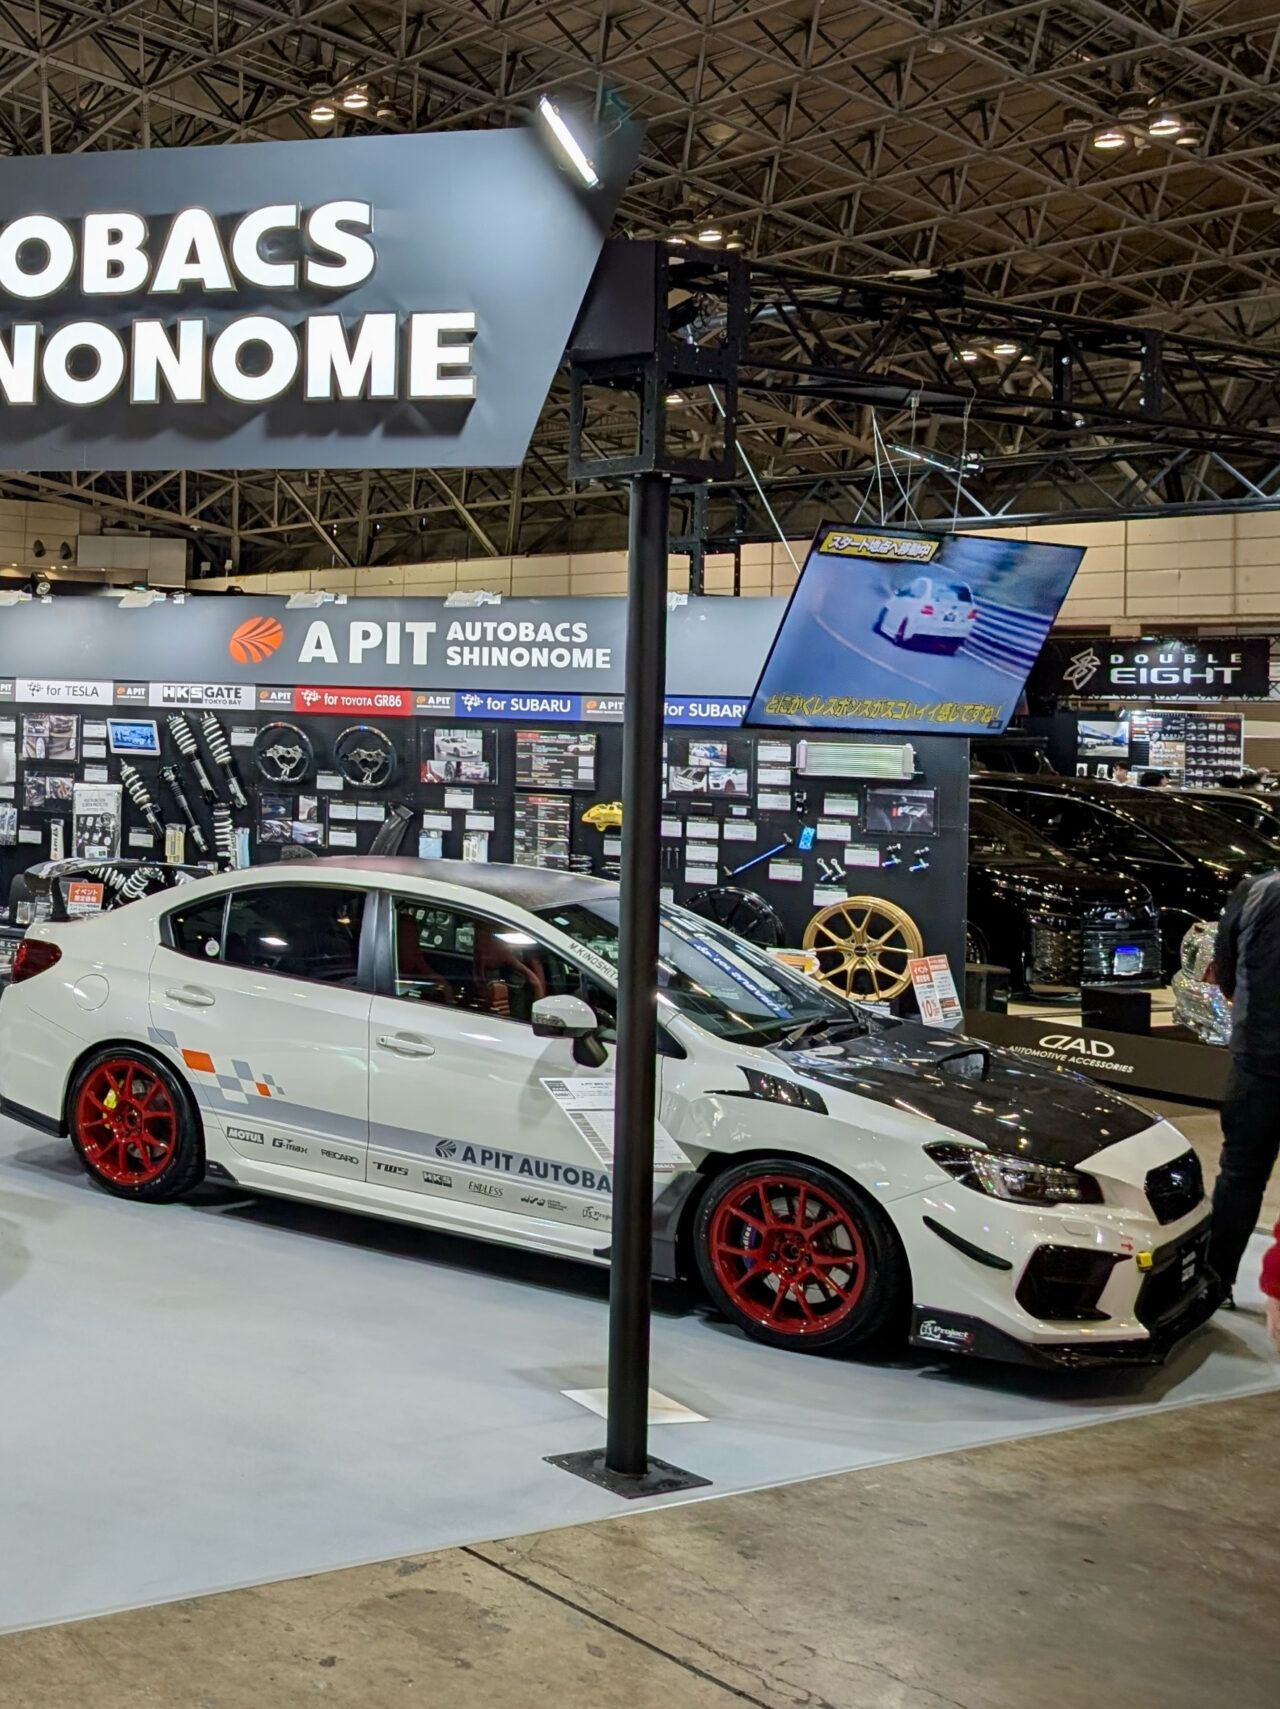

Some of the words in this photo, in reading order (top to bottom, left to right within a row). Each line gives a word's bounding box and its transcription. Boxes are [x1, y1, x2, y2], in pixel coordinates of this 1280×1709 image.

[446, 621, 589, 643] AUTOBACS
[446, 646, 612, 669] SHINONOME
[1110, 653, 1242, 665] DOUBLE
[1110, 667, 1242, 685] EIGHT
[46, 684, 62, 696] for
[65, 685, 100, 697] TESLA
[163, 685, 203, 704] HKS
[323, 692, 338, 706] for
[341, 696, 372, 707] TOYOTA
[373, 693, 403, 708] GR86
[486, 697, 507, 711] for
[510, 698, 571, 713] SUBARU
[663, 702, 685, 717] for
[688, 702, 746, 718] SUBAR
[74, 887, 99, 896] イベント
[569, 941, 618, 980] M.KINOSHIT
[1007, 1044, 1068, 1062] AUTOMOTIVE
[1068, 1055, 1135, 1074] ACCESSORIES
[227, 1128, 265, 1145] MOTUL
[320, 1148, 360, 1166] RECARO
[372, 1160, 409, 1177] TWS
[518, 1157, 613, 1194] AUTOBA
[422, 1171, 453, 1188] HKS
[468, 1180, 505, 1198] ENDLESS
